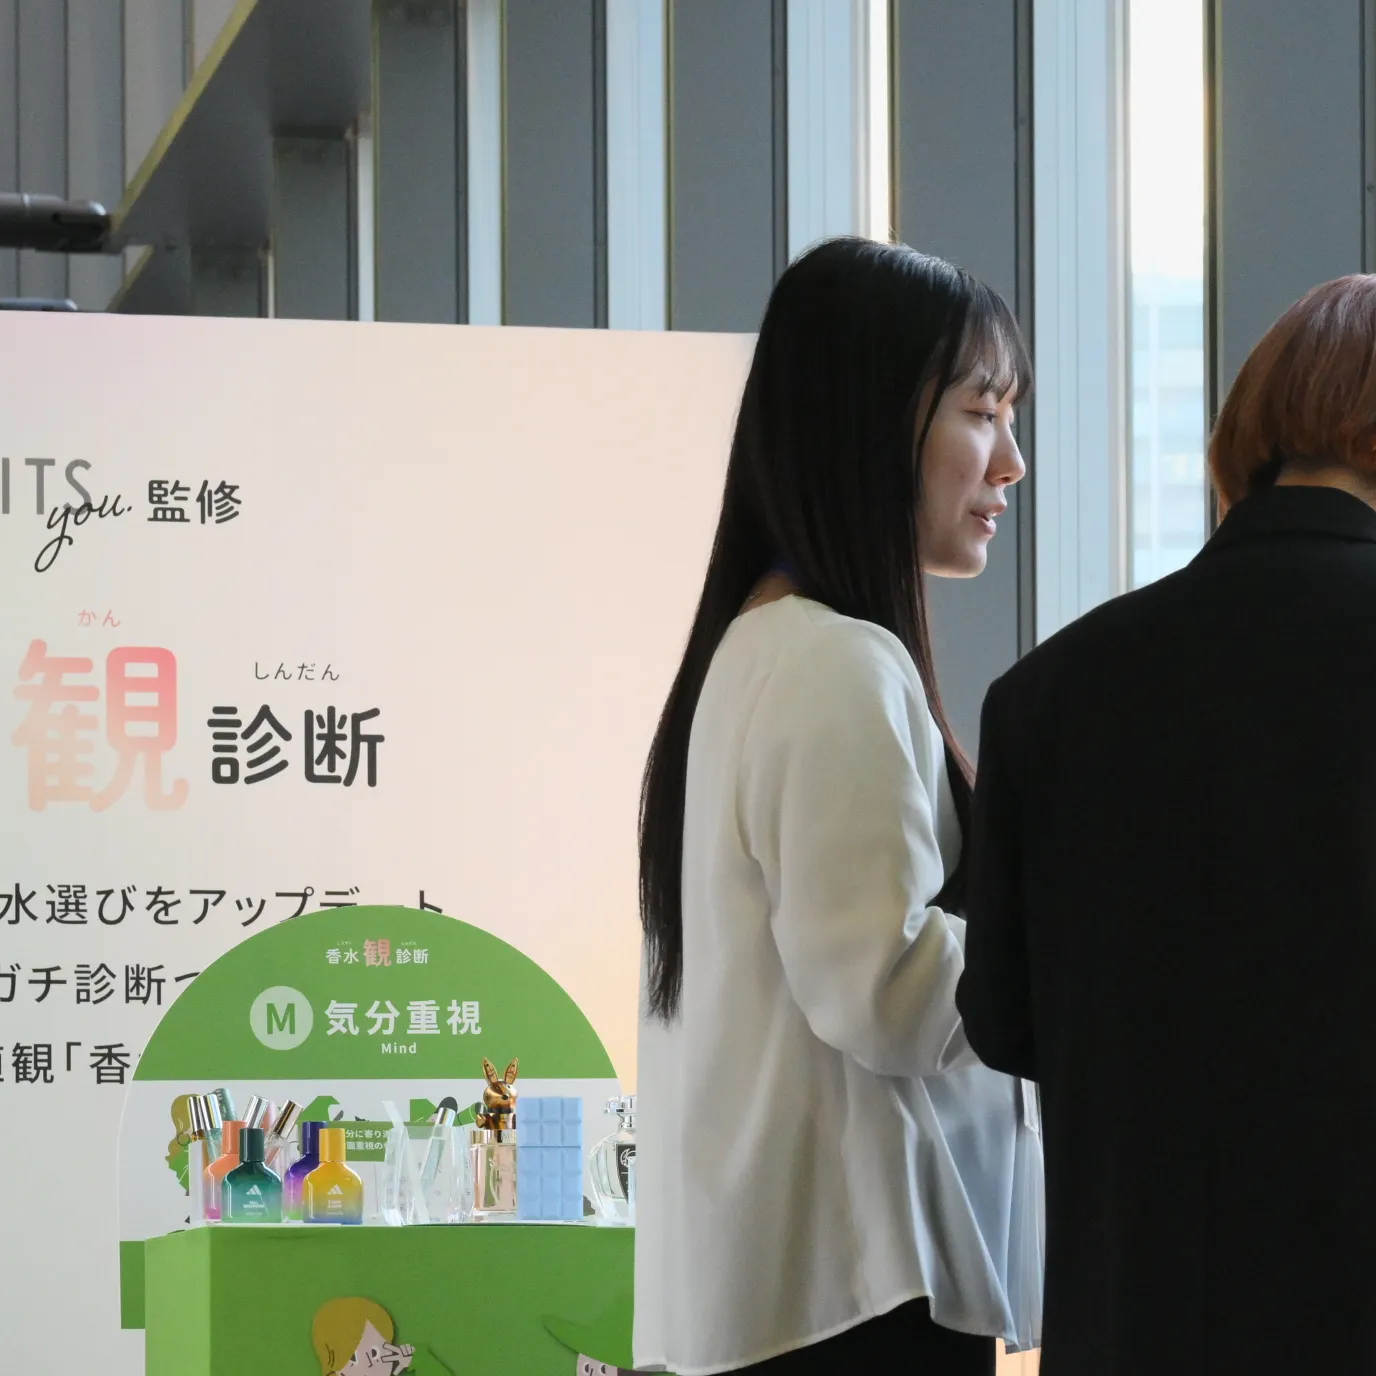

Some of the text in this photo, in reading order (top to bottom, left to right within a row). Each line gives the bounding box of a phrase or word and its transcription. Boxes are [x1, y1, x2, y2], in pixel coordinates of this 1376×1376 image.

[147, 479, 242, 524] 監修
[77, 609, 122, 628] かん
[253, 661, 341, 683] しんだん
[265, 999, 482, 1036] M 気分重視
[381, 1041, 418, 1055] Mind
